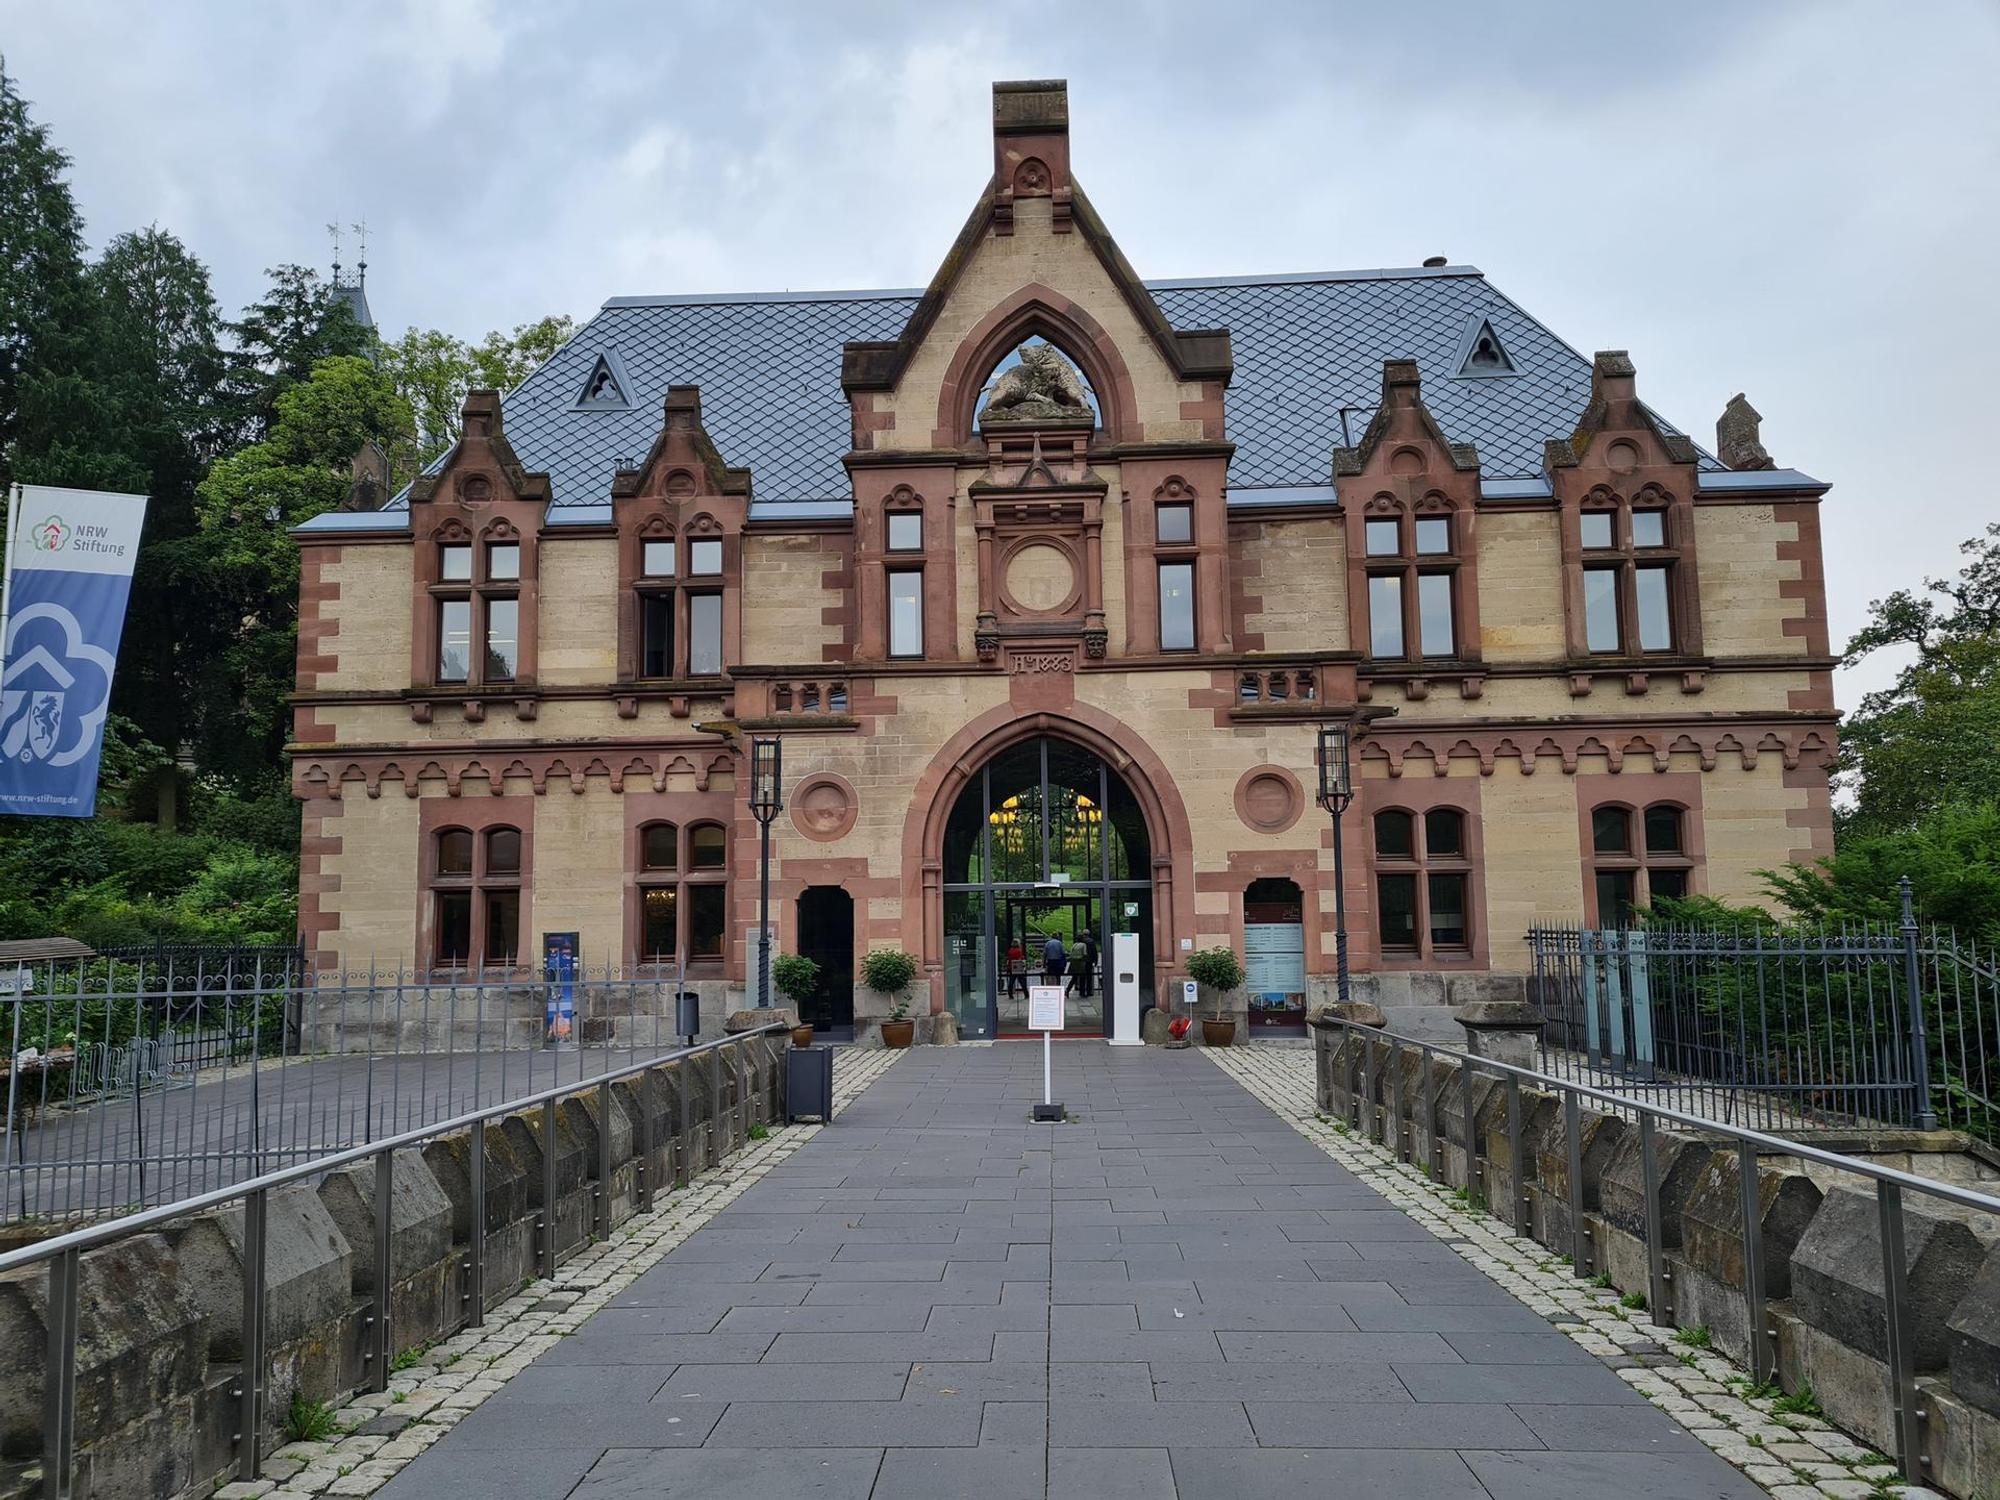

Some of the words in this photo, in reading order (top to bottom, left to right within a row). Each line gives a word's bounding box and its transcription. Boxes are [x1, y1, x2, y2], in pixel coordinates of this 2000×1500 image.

[76, 524, 108, 538] NRW
[72, 539, 125, 556] Stiftung
[0, 794, 79, 805] ww.nrw-stiftung.de
